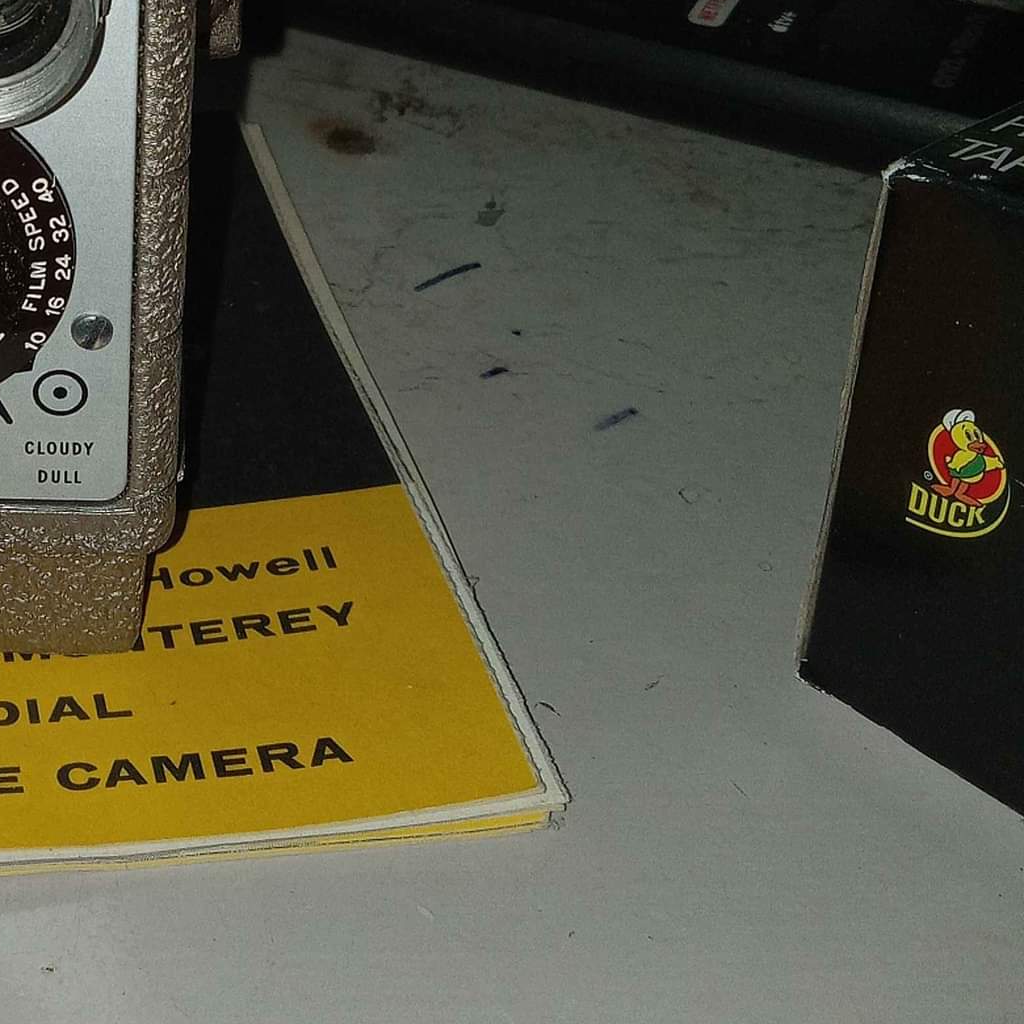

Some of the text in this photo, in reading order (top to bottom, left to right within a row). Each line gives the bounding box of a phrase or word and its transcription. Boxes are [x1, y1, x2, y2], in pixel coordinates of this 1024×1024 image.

[1, 178, 47, 312] FILM SPEED
[25, 177, 72, 350] 10 16 24 32 40
[24, 440, 95, 456] CLOUDY
[38, 469, 82, 484] DULL
[908, 481, 986, 528] DUCK
[3, 601, 354, 662] TEREY
[57, 736, 354, 792] CAMERA
